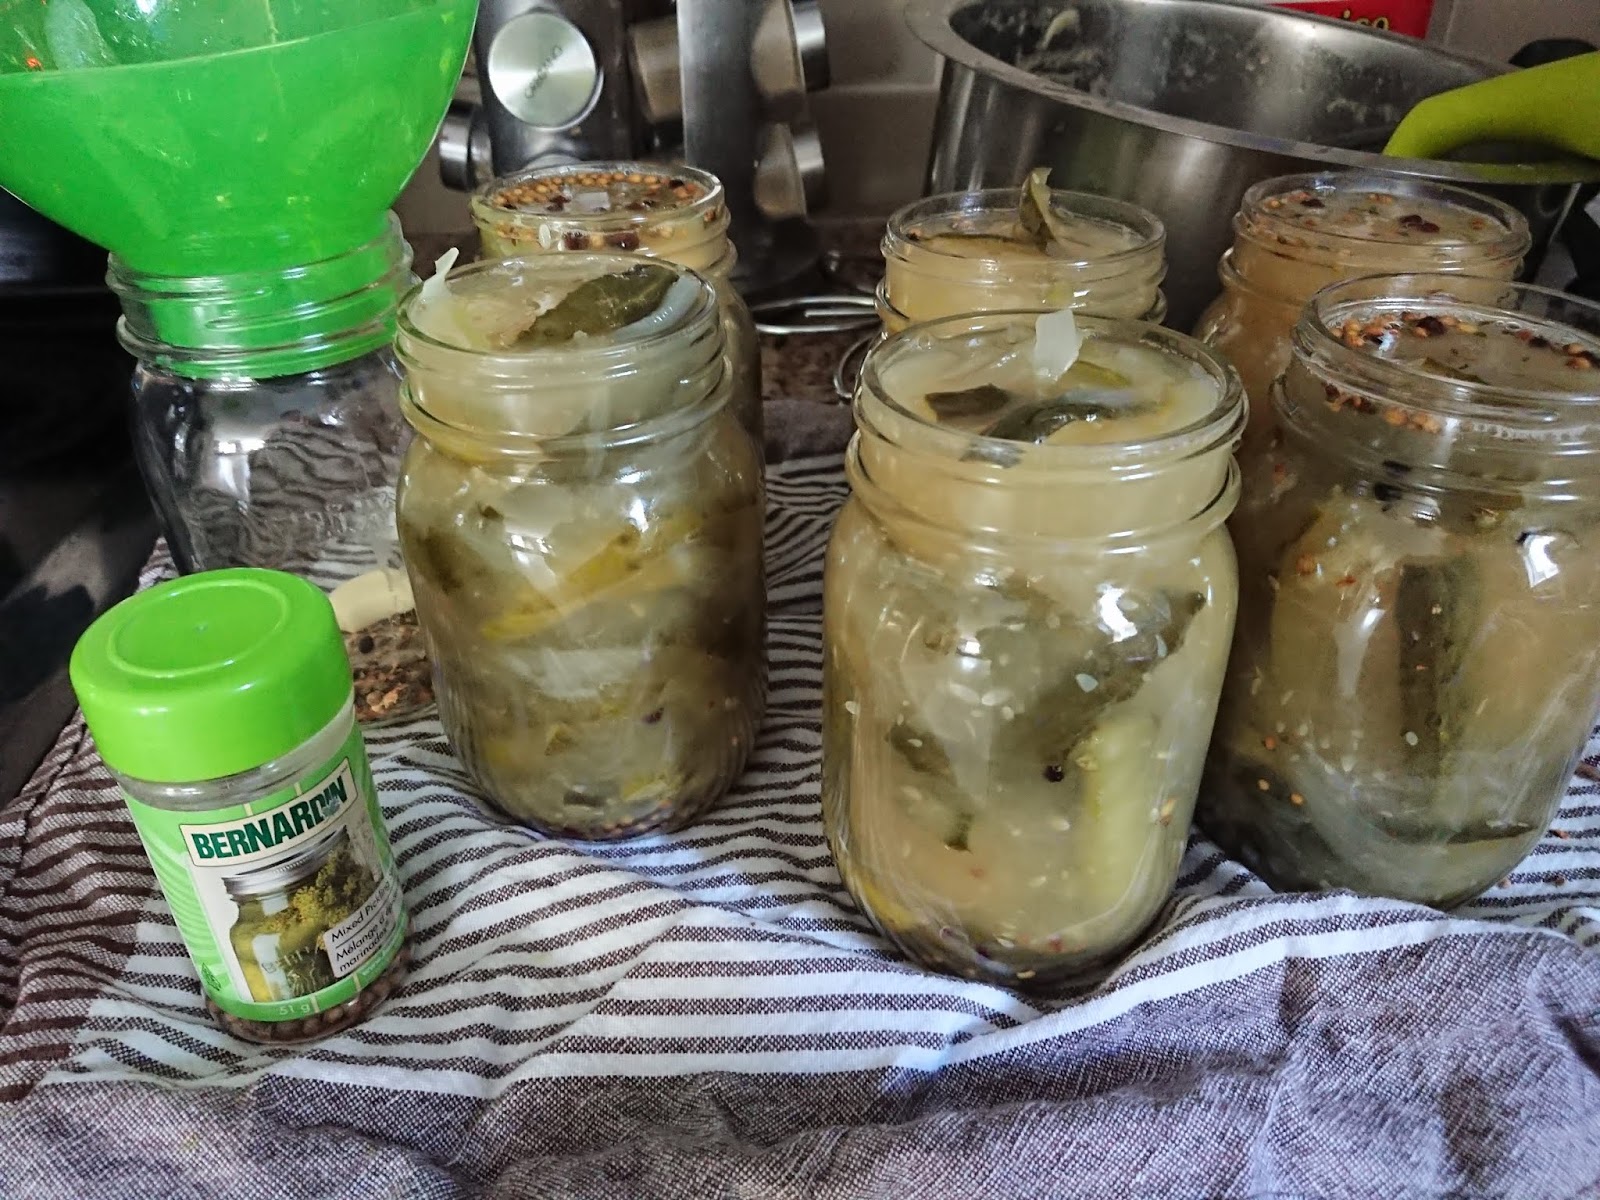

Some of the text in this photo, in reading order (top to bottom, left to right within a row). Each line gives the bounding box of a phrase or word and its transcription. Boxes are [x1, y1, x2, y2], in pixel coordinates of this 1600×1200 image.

[191, 775, 348, 859] BERNARDIN
[331, 911, 364, 942] Mixed
[280, 1004, 310, 1015] 51 g
